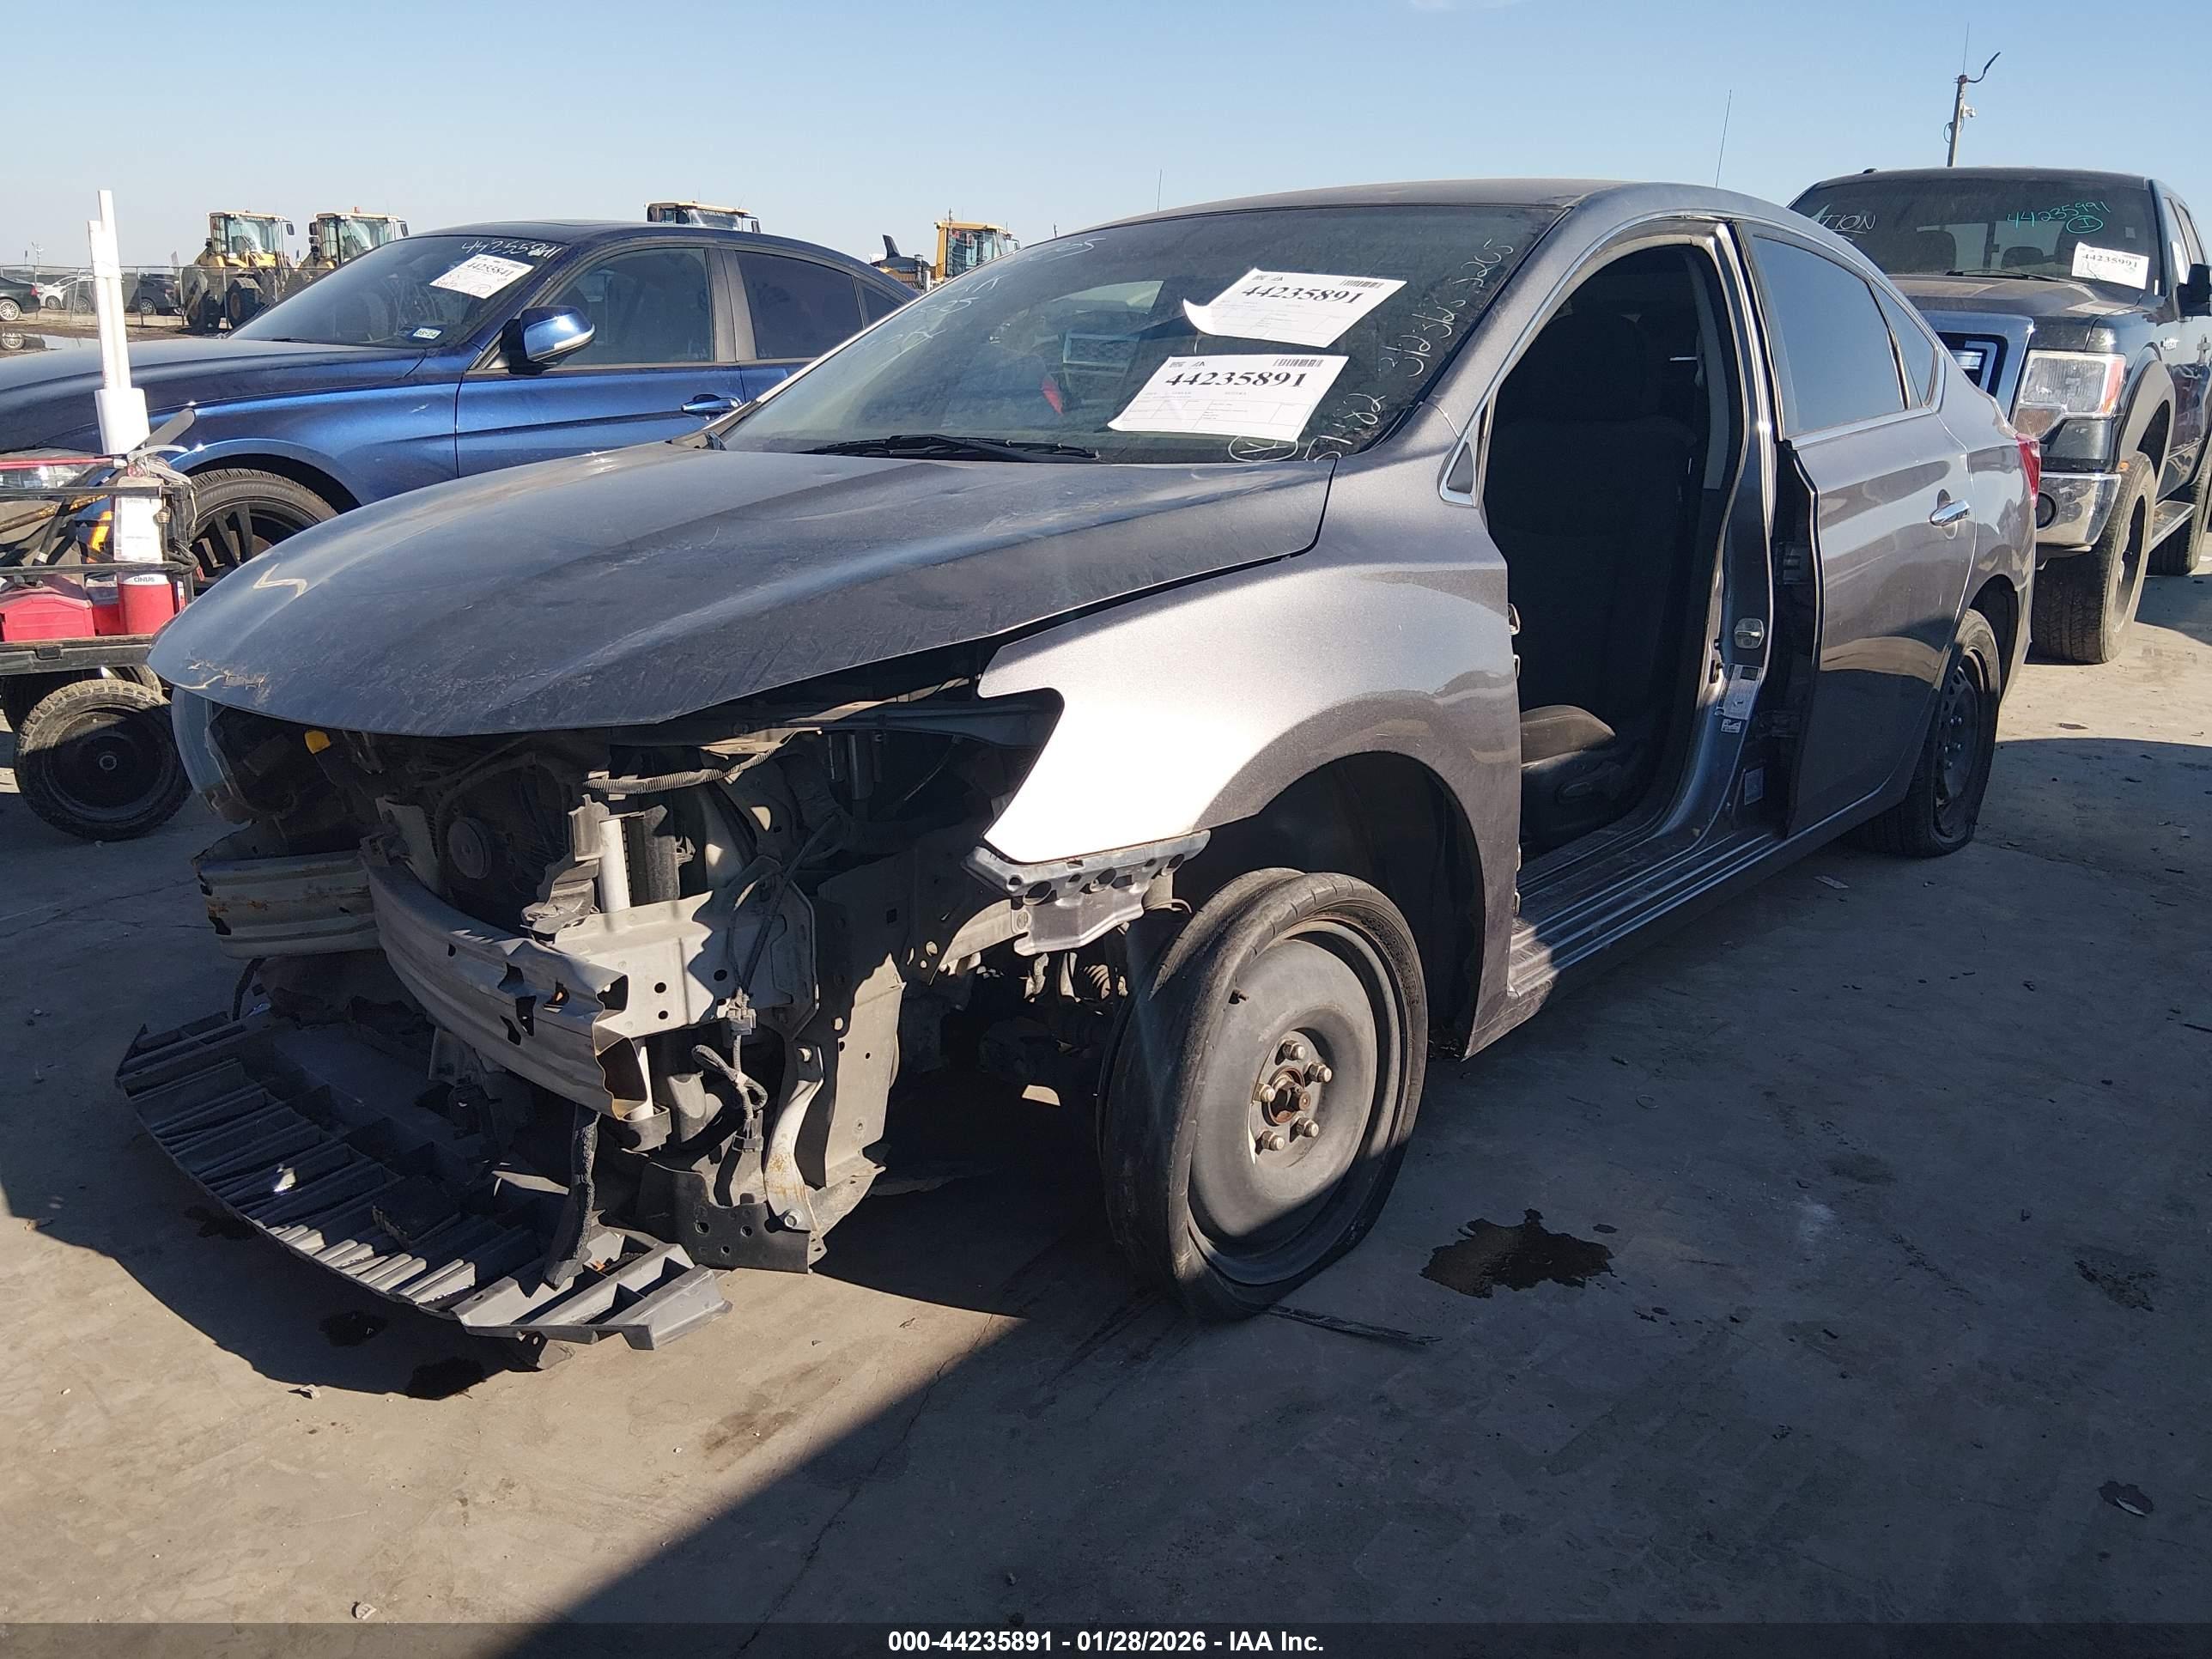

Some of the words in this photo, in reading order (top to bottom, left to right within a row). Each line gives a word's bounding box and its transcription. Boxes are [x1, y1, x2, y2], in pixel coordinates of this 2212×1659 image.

[2002, 201, 2111, 229] 44235991
[2082, 254, 2137, 268] 44235991
[1242, 285, 1364, 305] 44235891
[1165, 371, 1308, 388] 44235891
